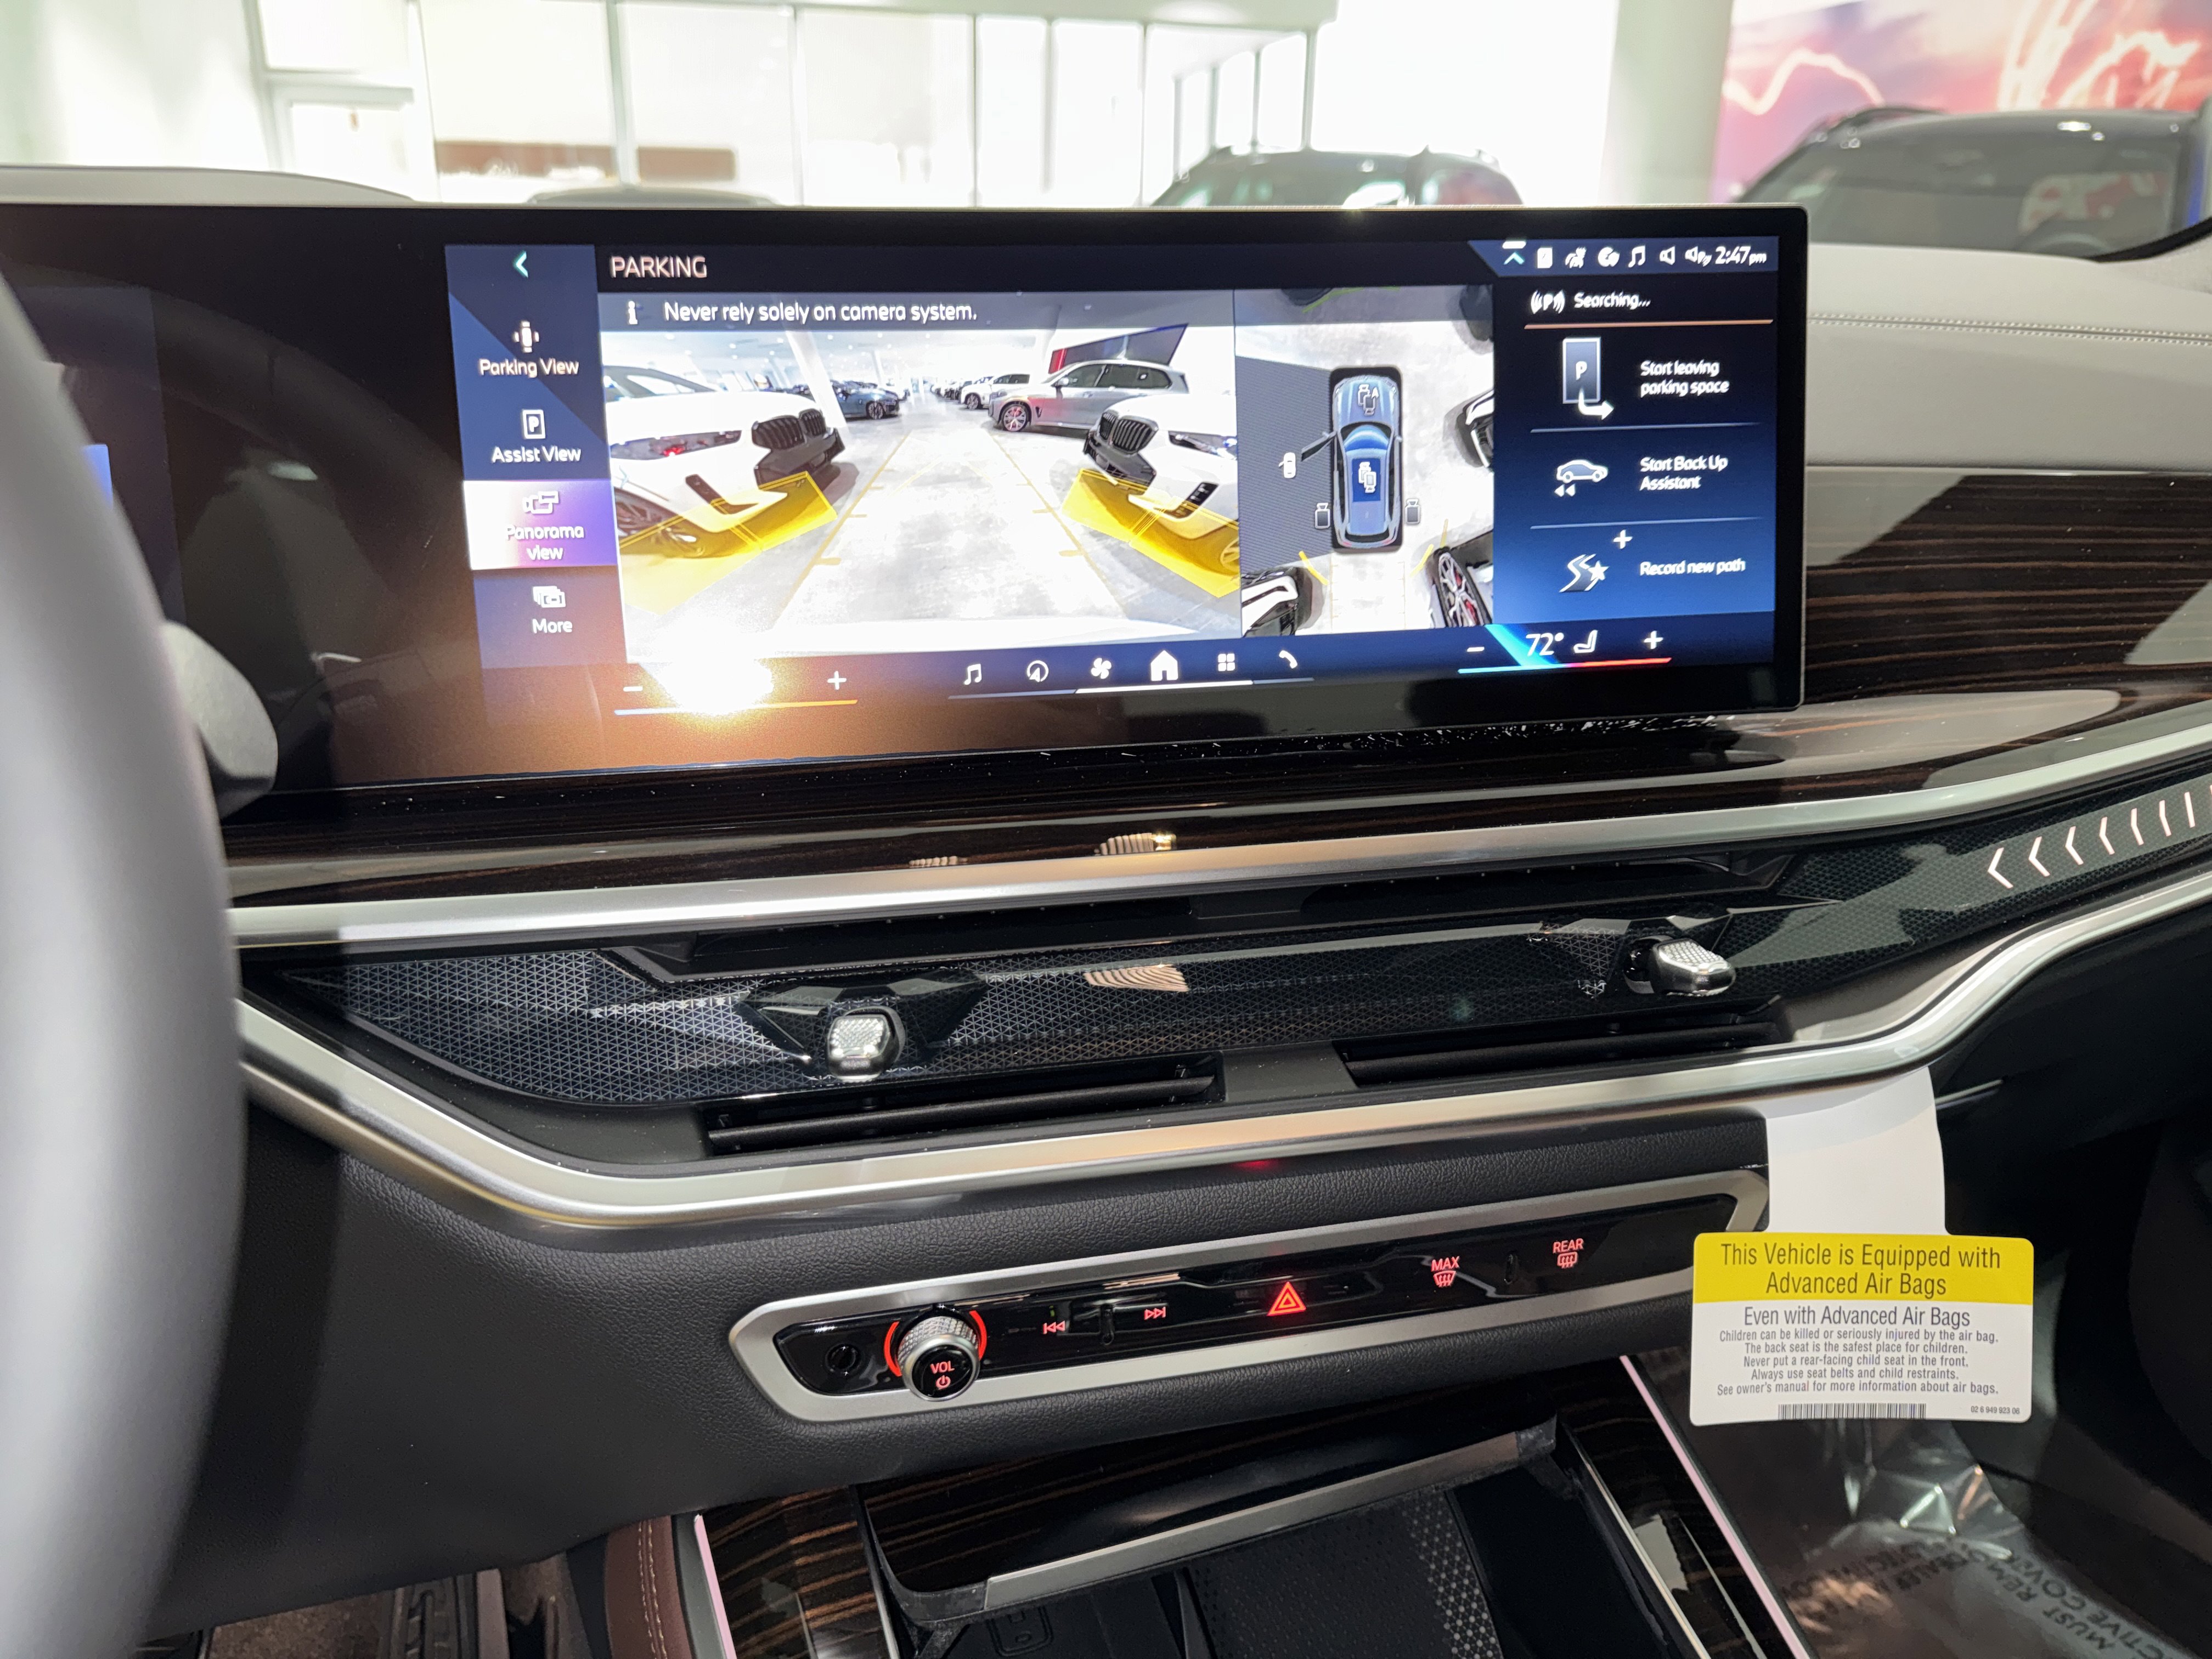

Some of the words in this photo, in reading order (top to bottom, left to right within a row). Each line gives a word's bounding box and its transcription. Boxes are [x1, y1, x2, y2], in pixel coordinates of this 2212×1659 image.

[610, 256, 708, 278] PARKING
[1573, 292, 1651, 310] Searching...
[664, 302, 719, 321] Never
[722, 302, 755, 324] rely
[758, 302, 809, 324] solely
[813, 304, 836, 321] on
[840, 304, 906, 321] camera
[911, 303, 978, 324] system.
[479, 358, 538, 378] Parking
[540, 358, 579, 375] View
[1640, 360, 1673, 376] Start
[1674, 359, 1720, 376] leaving
[1640, 380, 1689, 398] parking
[1690, 380, 1730, 396] space
[492, 447, 540, 463] Assist
[542, 447, 582, 462] View
[1640, 455, 1674, 473] Start
[1674, 455, 1708, 472] Back
[1708, 454, 1729, 471] Up
[1639, 475, 1702, 491] Assistant
[505, 524, 584, 540] Panorama
[1639, 561, 1686, 575] Record
[1686, 560, 1716, 574] new
[1716, 558, 1746, 575] path
[532, 619, 572, 633] More
[1553, 1238, 1584, 1253] REAR
[1431, 1256, 1460, 1271] MAX
[1721, 1243, 1757, 1265] This
[1764, 1242, 1831, 1265] Vehicle
[1839, 1243, 1854, 1265] is
[1861, 1243, 1950, 1271] Equipped
[1958, 1246, 2001, 1268] with
[1765, 1271, 1858, 1294] Advanced
[1865, 1272, 1893, 1294] Air
[1900, 1273, 1946, 1300] Bags
[1745, 1306, 1779, 1325] Even
[1784, 1305, 1816, 1324] with
[1820, 1305, 1898, 1325] Advanced
[1902, 1306, 1926, 1325] Air
[1931, 1306, 1971, 1330] Bags
[1720, 1329, 1757, 1342] Children
[1760, 1330, 1776, 1340] can
[1780, 1328, 1791, 1340] be
[1795, 1328, 1820, 1339] killed
[1824, 1329, 1834, 1339] or
[1837, 1328, 1882, 1341] seriously
[1886, 1328, 1920, 1341] injured
[1924, 1329, 1936, 1342] by
[1939, 1329, 1955, 1341] the
[1959, 1330, 1973, 1341] air
[1976, 1330, 1999, 1344] bag.
[1745, 1342, 1762, 1354] The
[1765, 1341, 1787, 1353] back
[1790, 1341, 1809, 1352] seat
[1813, 1341, 1821, 1352] is
[1824, 1341, 1839, 1352] the
[1843, 1341, 1872, 1353] safest
[1876, 1341, 1902, 1355] place
[1905, 1341, 1920, 1353] for
[1923, 1341, 1968, 1354] children.
[930, 1361, 955, 1374] VOL
[1743, 1356, 1770, 1368] Never
[1773, 1355, 1788, 1368] put
[1791, 1356, 1797, 1365] a
[1801, 1354, 1853, 1367] rear-facing
[1857, 1354, 1881, 1365] child
[1884, 1355, 1905, 1366] seat
[1908, 1355, 1917, 1366] in
[1921, 1355, 1937, 1366] the
[1940, 1355, 1968, 1367] front.
[1751, 1369, 1784, 1381] Always
[1787, 1369, 1804, 1379] use
[1807, 1367, 1827, 1379] seat
[1830, 1367, 1854, 1379] belts
[1858, 1367, 1876, 1379] and
[1879, 1367, 1903, 1379] child
[1907, 1368, 1959, 1380] restraints.
[1717, 1384, 1734, 1396] See
[1736, 1381, 1772, 1395] owner's
[1775, 1380, 1809, 1392] manual
[1813, 1380, 1827, 1392] for
[1830, 1381, 1855, 1392] more
[1859, 1380, 1917, 1392] information
[1921, 1381, 1949, 1392] about
[1953, 1381, 1967, 1392] air
[1971, 1381, 1999, 1395] bags.
[2042, 1606, 2115, 1650] MUST
[2086, 1609, 2168, 1659] CTIVE
